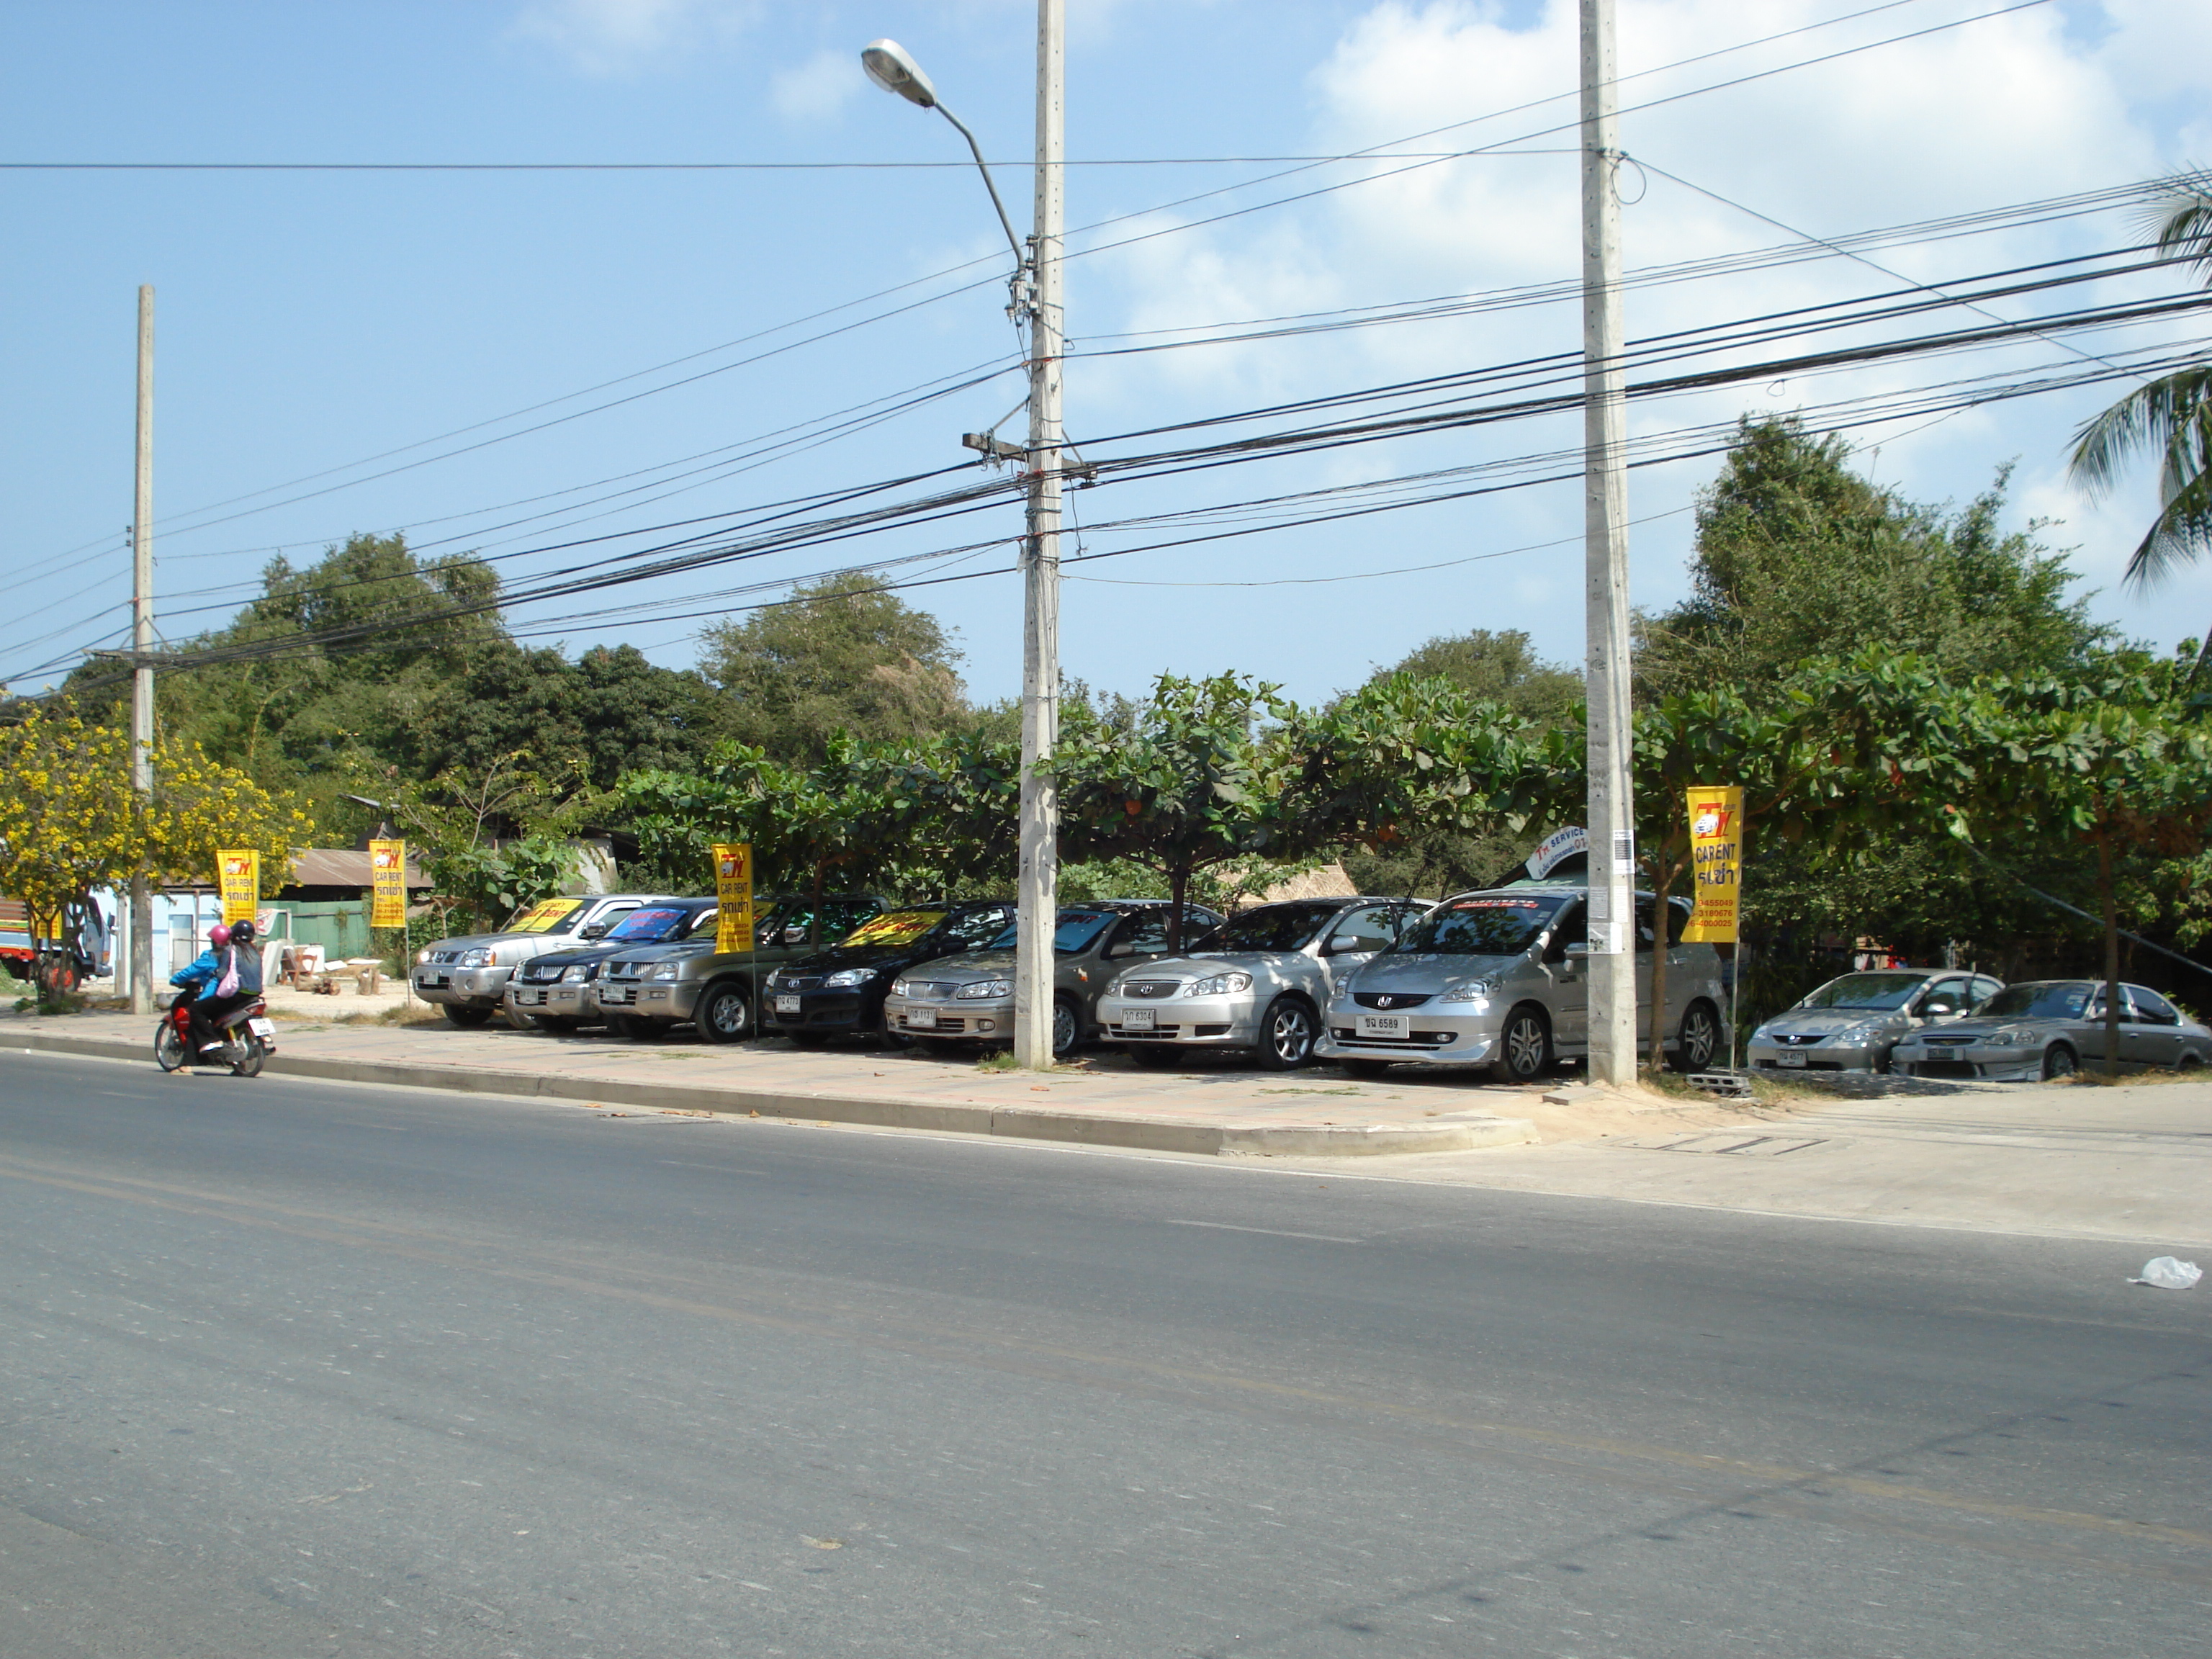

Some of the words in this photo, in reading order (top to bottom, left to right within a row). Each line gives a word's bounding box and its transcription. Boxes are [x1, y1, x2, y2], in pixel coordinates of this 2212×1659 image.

[1550, 827, 1584, 848] SERVICE
[375, 871, 387, 881] CAR
[389, 871, 403, 882] RENT
[225, 878, 237, 887] CAR
[239, 878, 254, 887] RENT
[721, 883, 732, 894] CAR
[734, 882, 748, 894] RENT
[226, 888, 254, 901] รถเช่า
[376, 883, 403, 896] รถเช่า
[721, 896, 749, 913] รถเช่า
[920, 1010, 933, 1020] 1131
[1136, 1011, 1151, 1020] 6304
[1379, 1018, 1398, 1029] 6589
